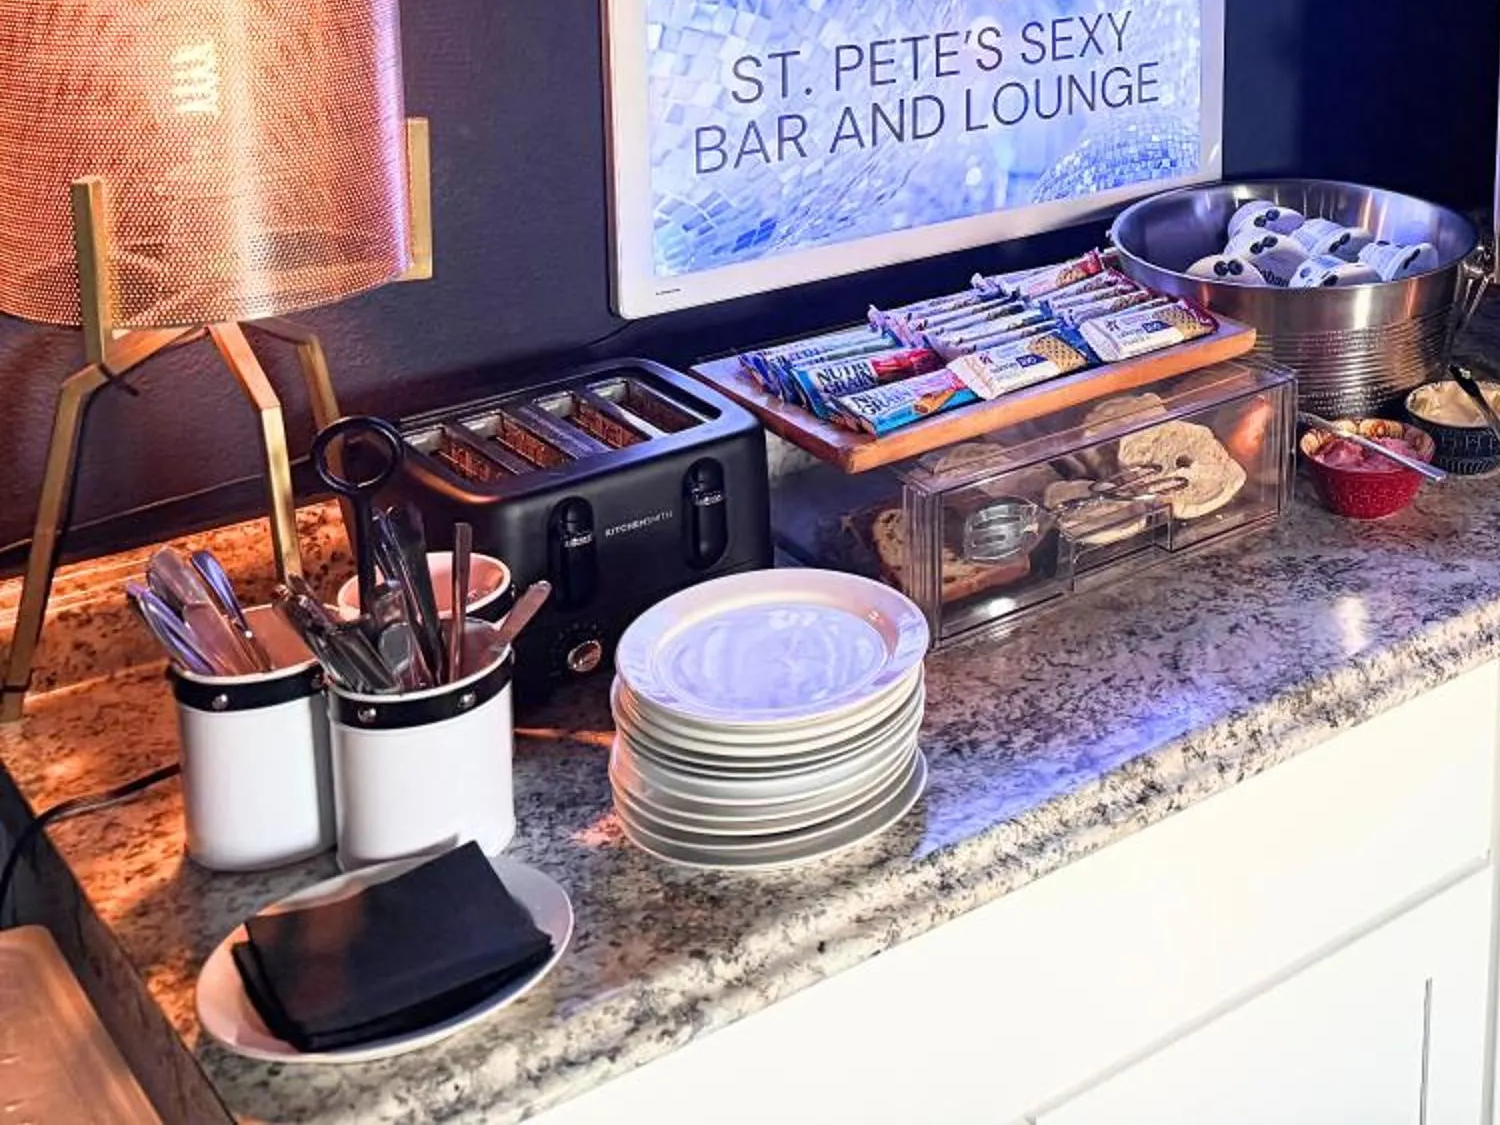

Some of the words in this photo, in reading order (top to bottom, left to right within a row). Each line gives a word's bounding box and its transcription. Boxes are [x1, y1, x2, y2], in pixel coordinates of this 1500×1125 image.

[731, 49, 815, 105] ST.
[834, 25, 1002, 92] PETE'S
[1020, 10, 1134, 65] SEXY
[695, 113, 808, 174] BAR
[829, 94, 946, 154] AND
[964, 62, 1161, 132] LOUNGE
